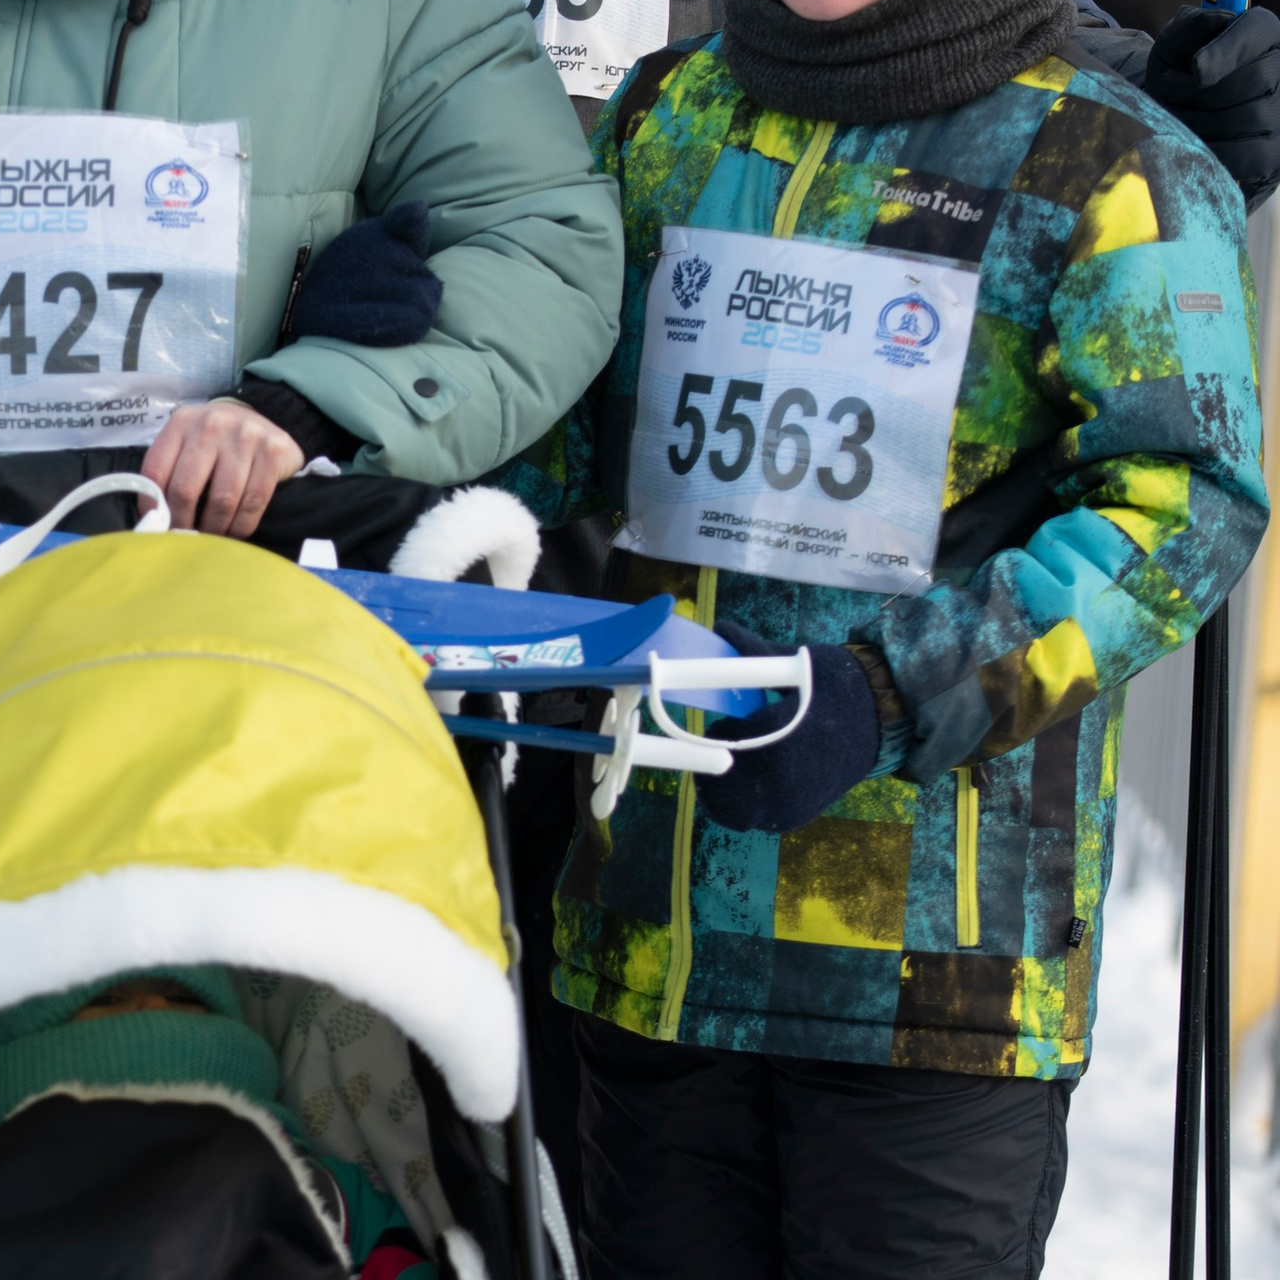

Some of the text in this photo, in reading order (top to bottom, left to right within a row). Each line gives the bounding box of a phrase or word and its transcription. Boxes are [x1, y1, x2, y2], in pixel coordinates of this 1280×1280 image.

[735, 269, 854, 308] ЛЫЖНЯ
[664, 316, 707, 330] МИНСПОРТ
[726, 293, 852, 335] РОССИИ
[667, 331, 698, 343] РОССИИ
[741, 321, 824, 356] 2025
[100, 412, 149, 428] ОКРУГ
[668, 373, 875, 501] 5563
[702, 510, 847, 542] ХАНТЫ-МАНСИЙСКИЙ
[699, 526, 789, 549] АВТОНОМНЫЙ
[795, 541, 844, 558] ОКРУГ
[866, 551, 909, 567] ЮГРА
